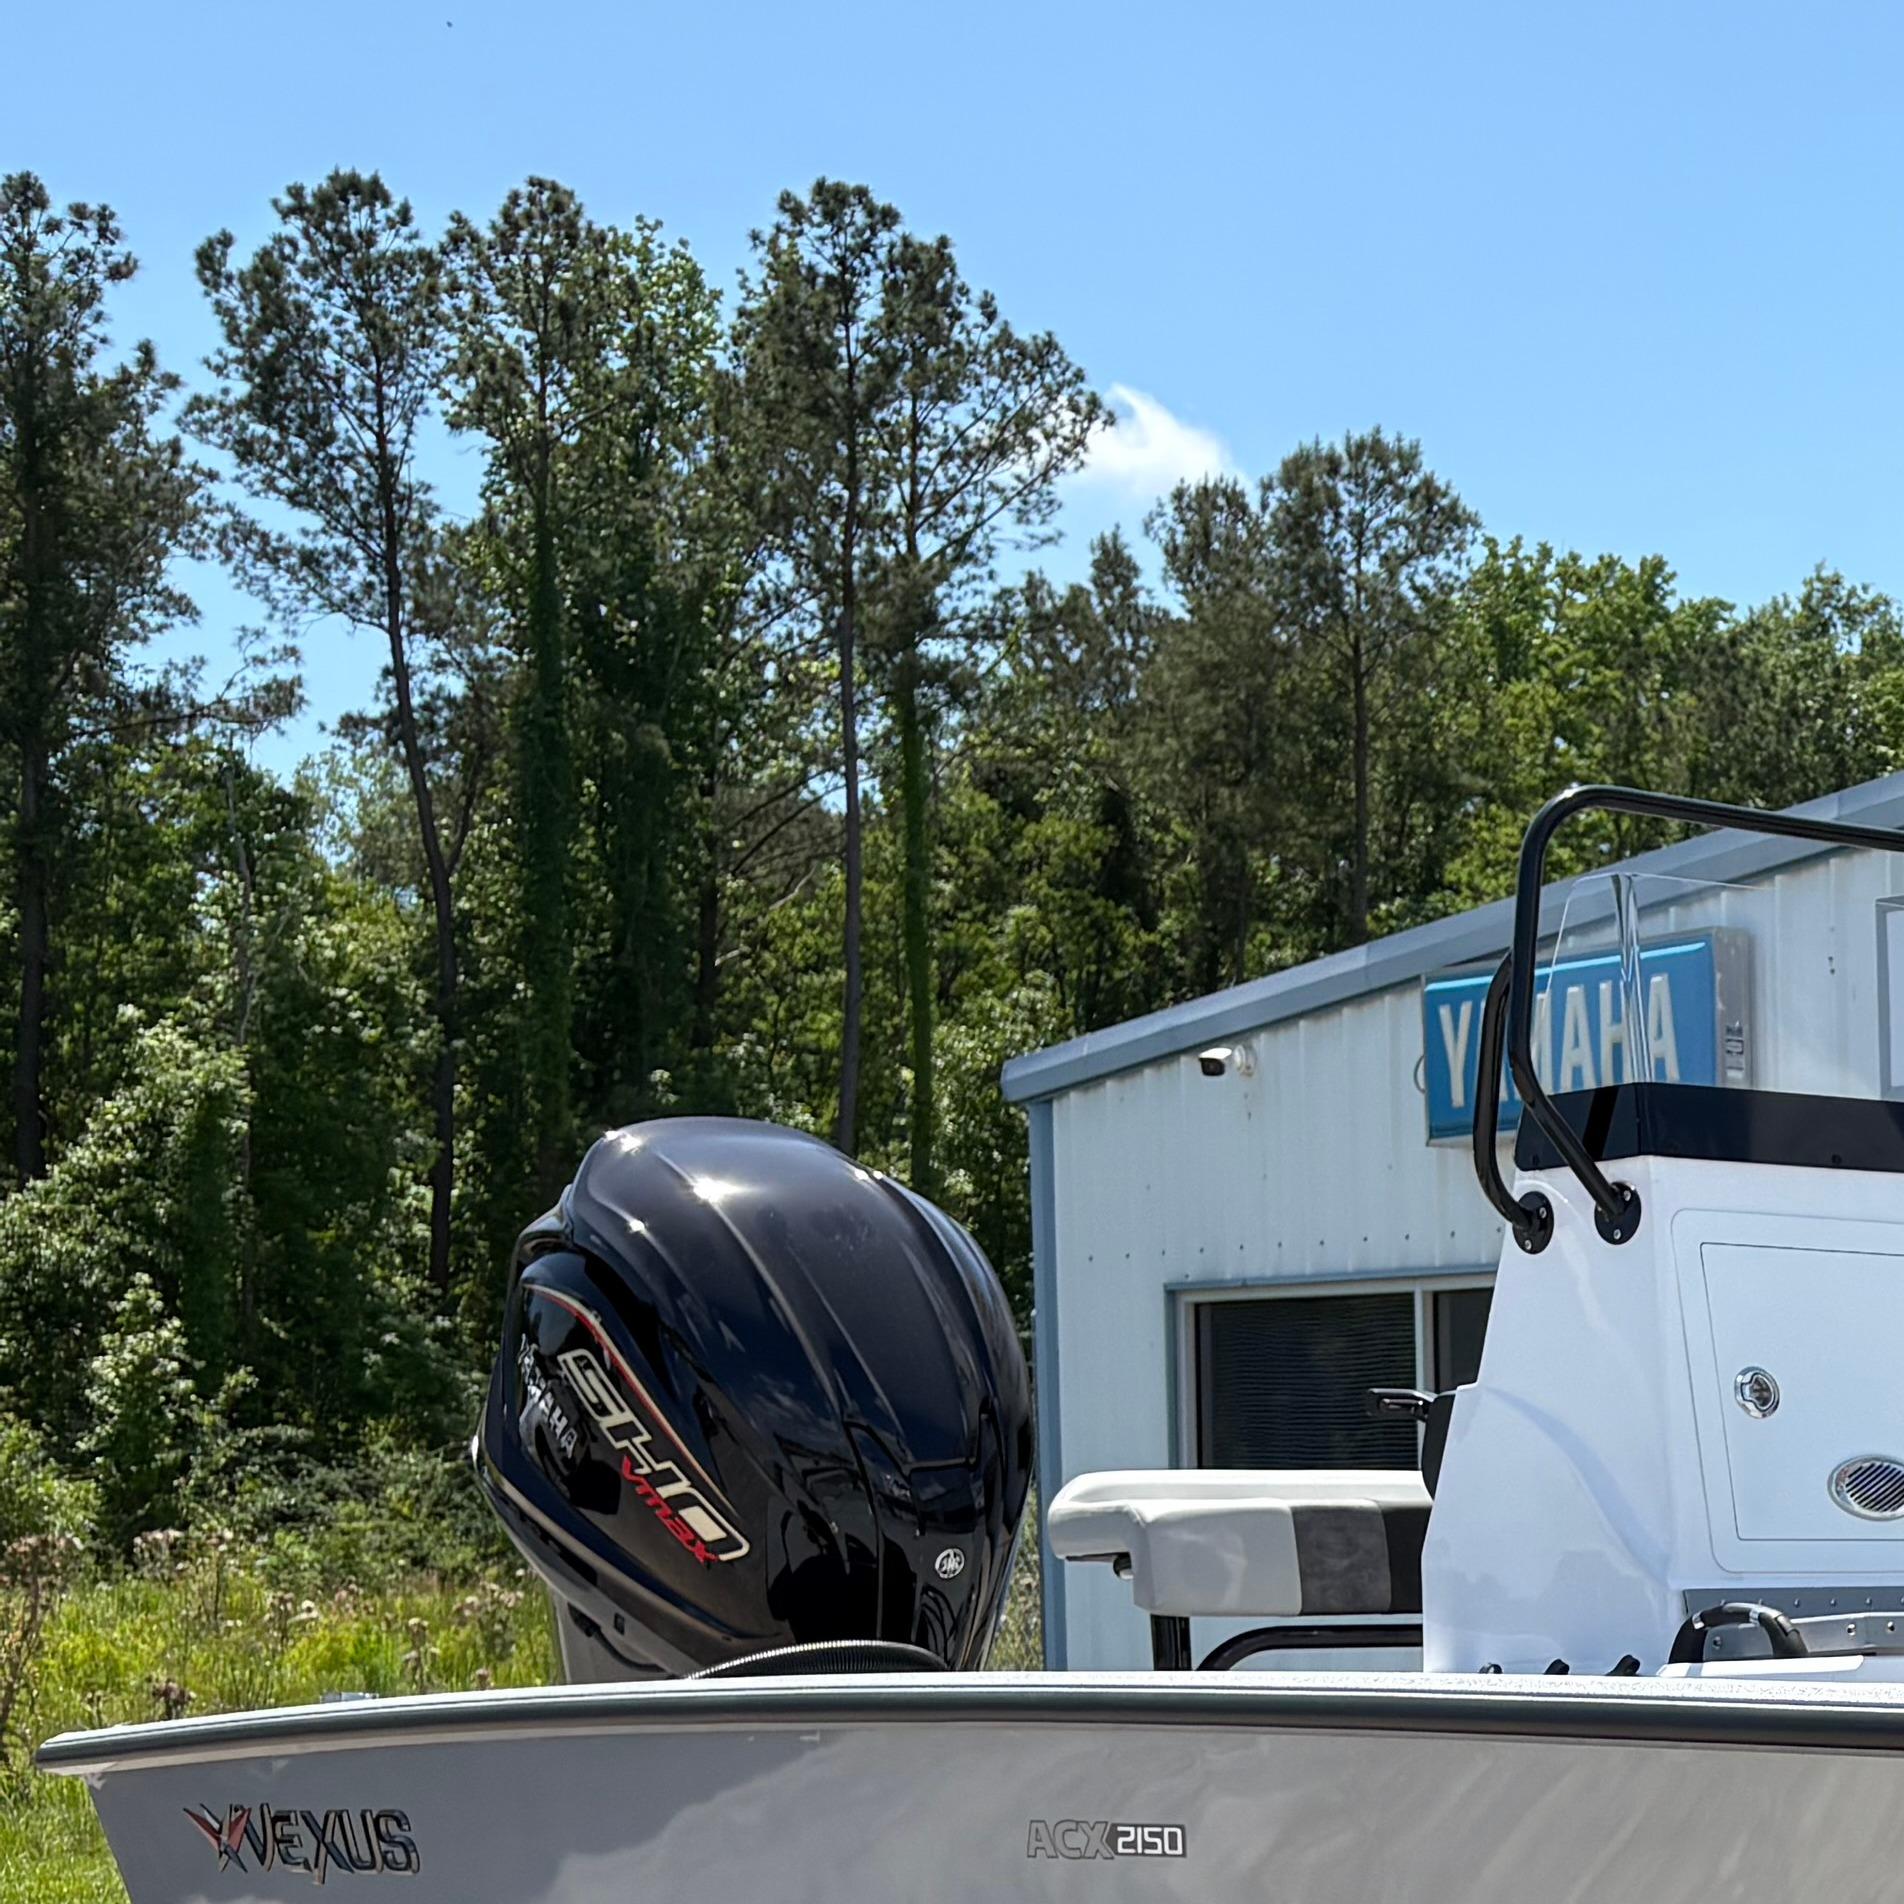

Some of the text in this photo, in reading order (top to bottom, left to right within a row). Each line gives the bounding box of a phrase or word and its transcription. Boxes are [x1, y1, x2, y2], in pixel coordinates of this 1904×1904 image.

[230, 1802, 421, 1885] VEXUS
[1026, 1818, 1184, 1860] ACX 2150
